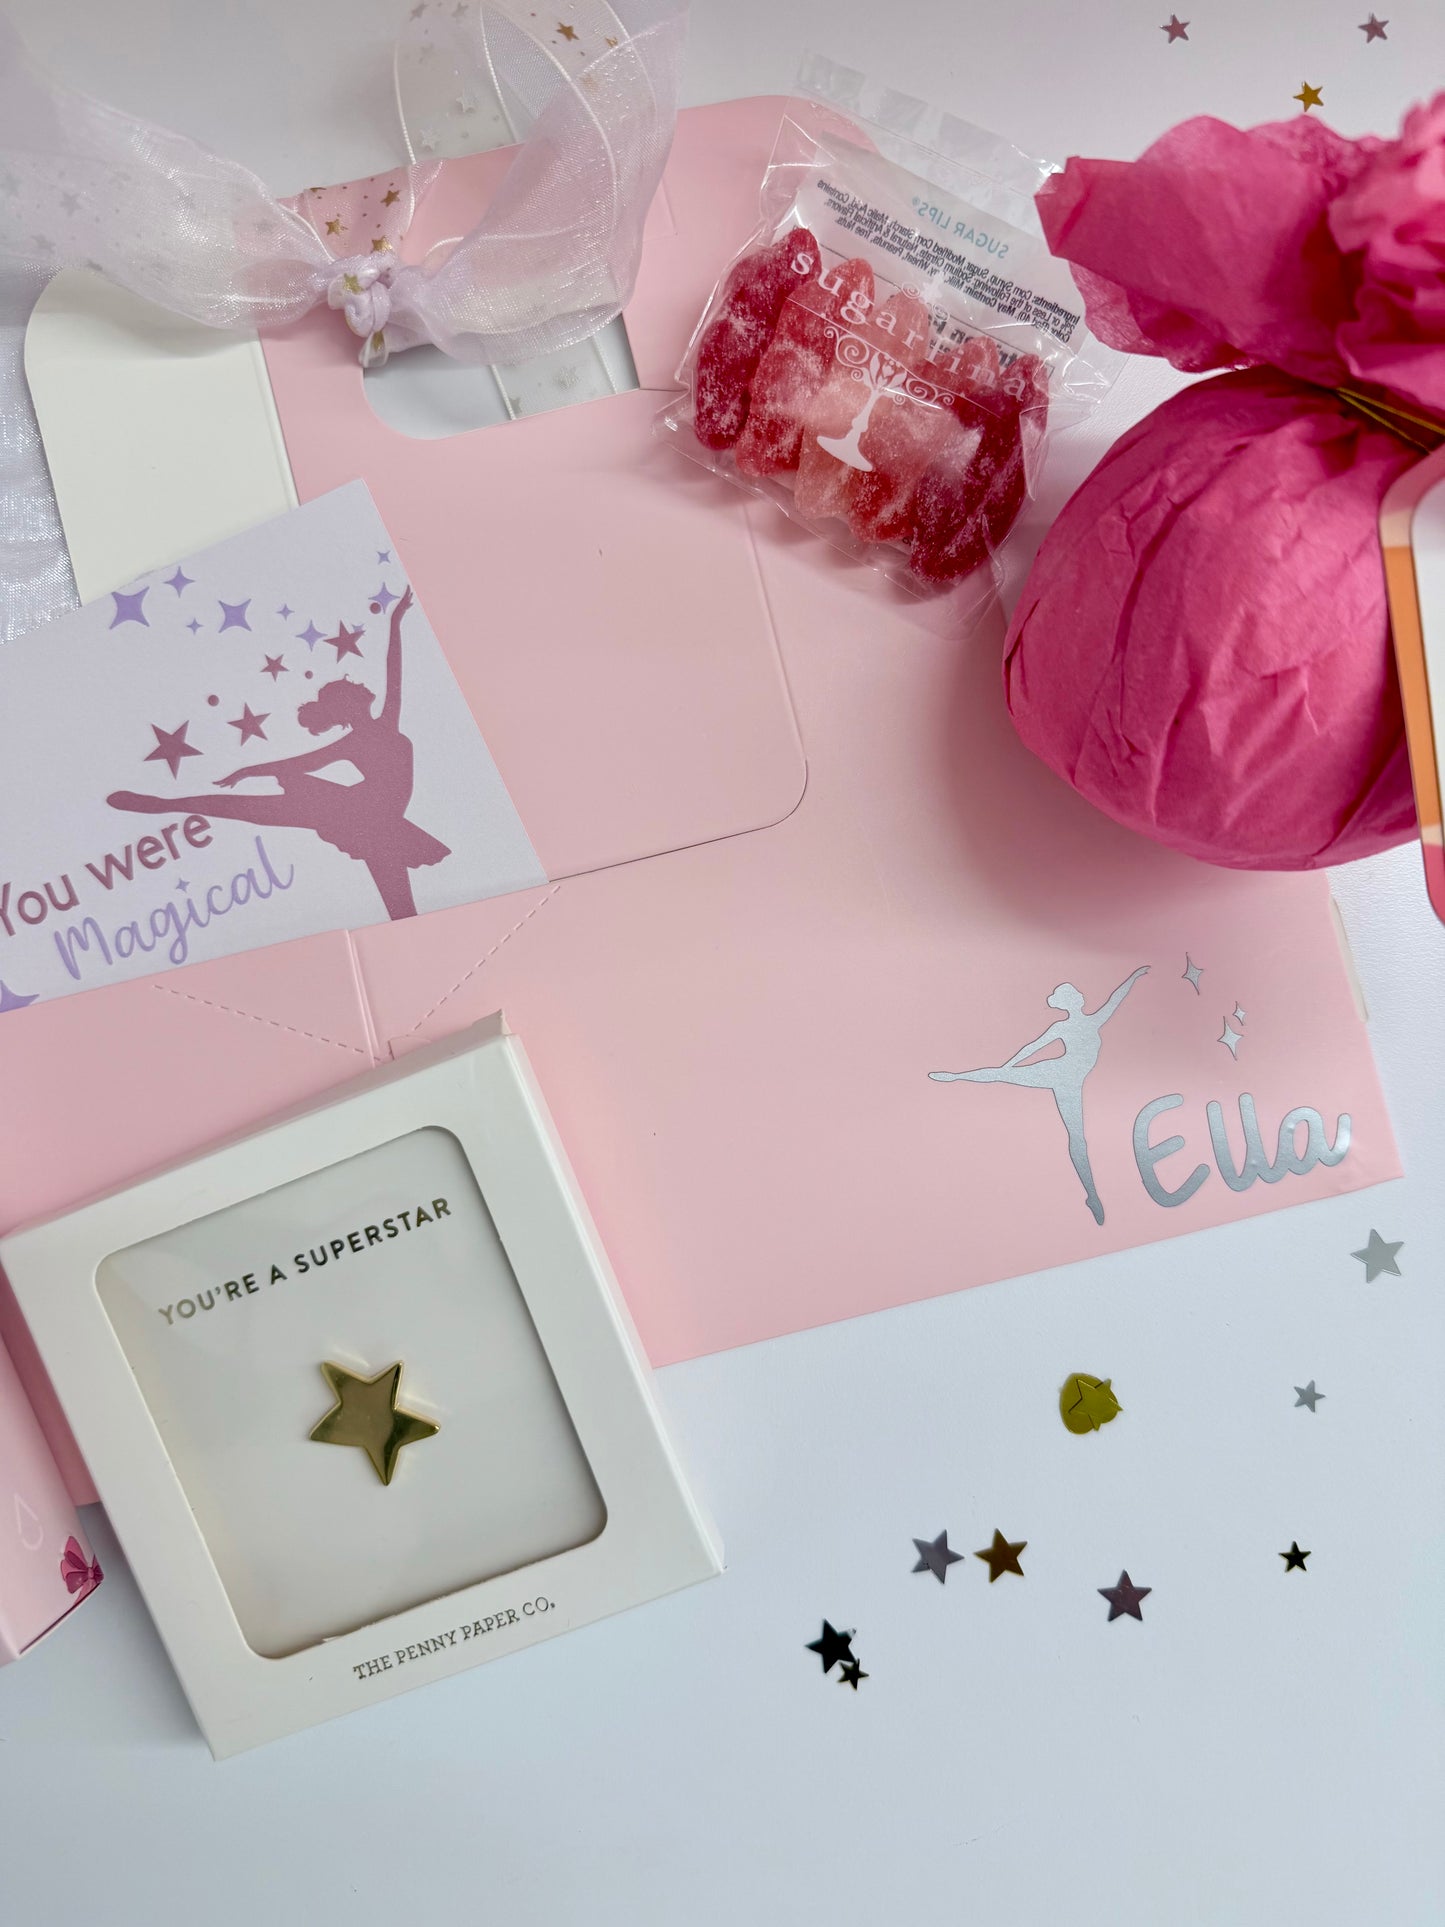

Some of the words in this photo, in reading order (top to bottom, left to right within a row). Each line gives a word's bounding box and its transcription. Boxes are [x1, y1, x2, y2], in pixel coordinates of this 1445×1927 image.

[790, 252, 1027, 401] sugarfina
[0, 873, 80, 937] You
[85, 814, 213, 890] were
[54, 835, 294, 980] Magical
[1132, 1092, 1351, 1207] Ella
[157, 1274, 260, 1327] YOU'RE
[269, 1264, 288, 1287] A
[295, 1198, 452, 1273] SUPERSTAR
[352, 1653, 394, 1680] THE
[395, 1629, 458, 1665] PENNY
[461, 1609, 521, 1640] PAPER
[523, 1596, 556, 1617] CO.
